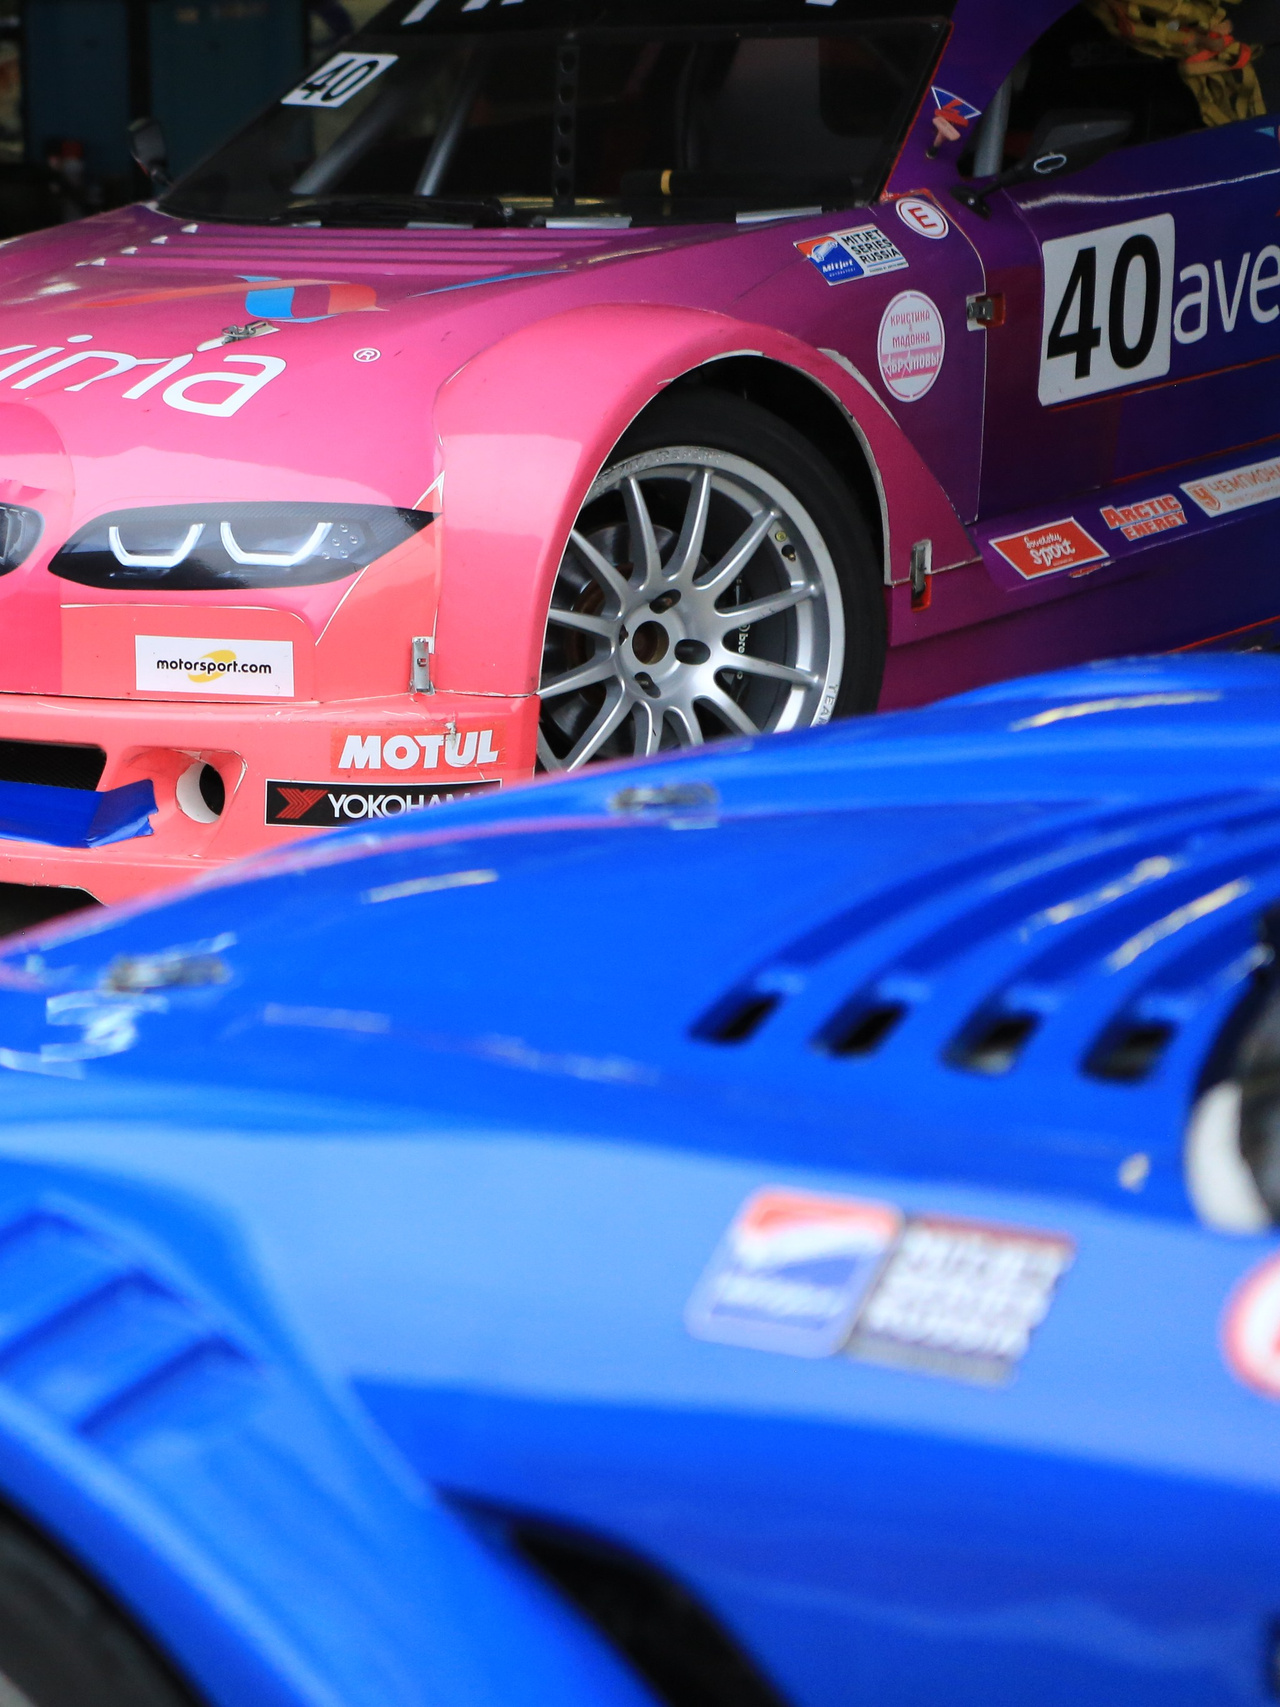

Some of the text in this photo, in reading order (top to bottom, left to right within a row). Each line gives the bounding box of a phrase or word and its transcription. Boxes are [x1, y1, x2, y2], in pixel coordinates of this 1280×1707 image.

[301, 58, 379, 101] 40
[908, 207, 938, 229] E
[841, 230, 883, 246] MITJET
[851, 238, 893, 255] SERIES
[859, 248, 902, 264] RUSSIA
[1174, 245, 1280, 345] ave
[1047, 234, 1161, 379] 40
[890, 310, 931, 327] КРИСТИНА
[893, 332, 931, 348] МАДОННА
[1121, 511, 1188, 541] ENERGY
[156, 658, 272, 675] motorsport.com
[338, 730, 499, 770] MOTUL
[327, 791, 484, 818] YOKOHA
